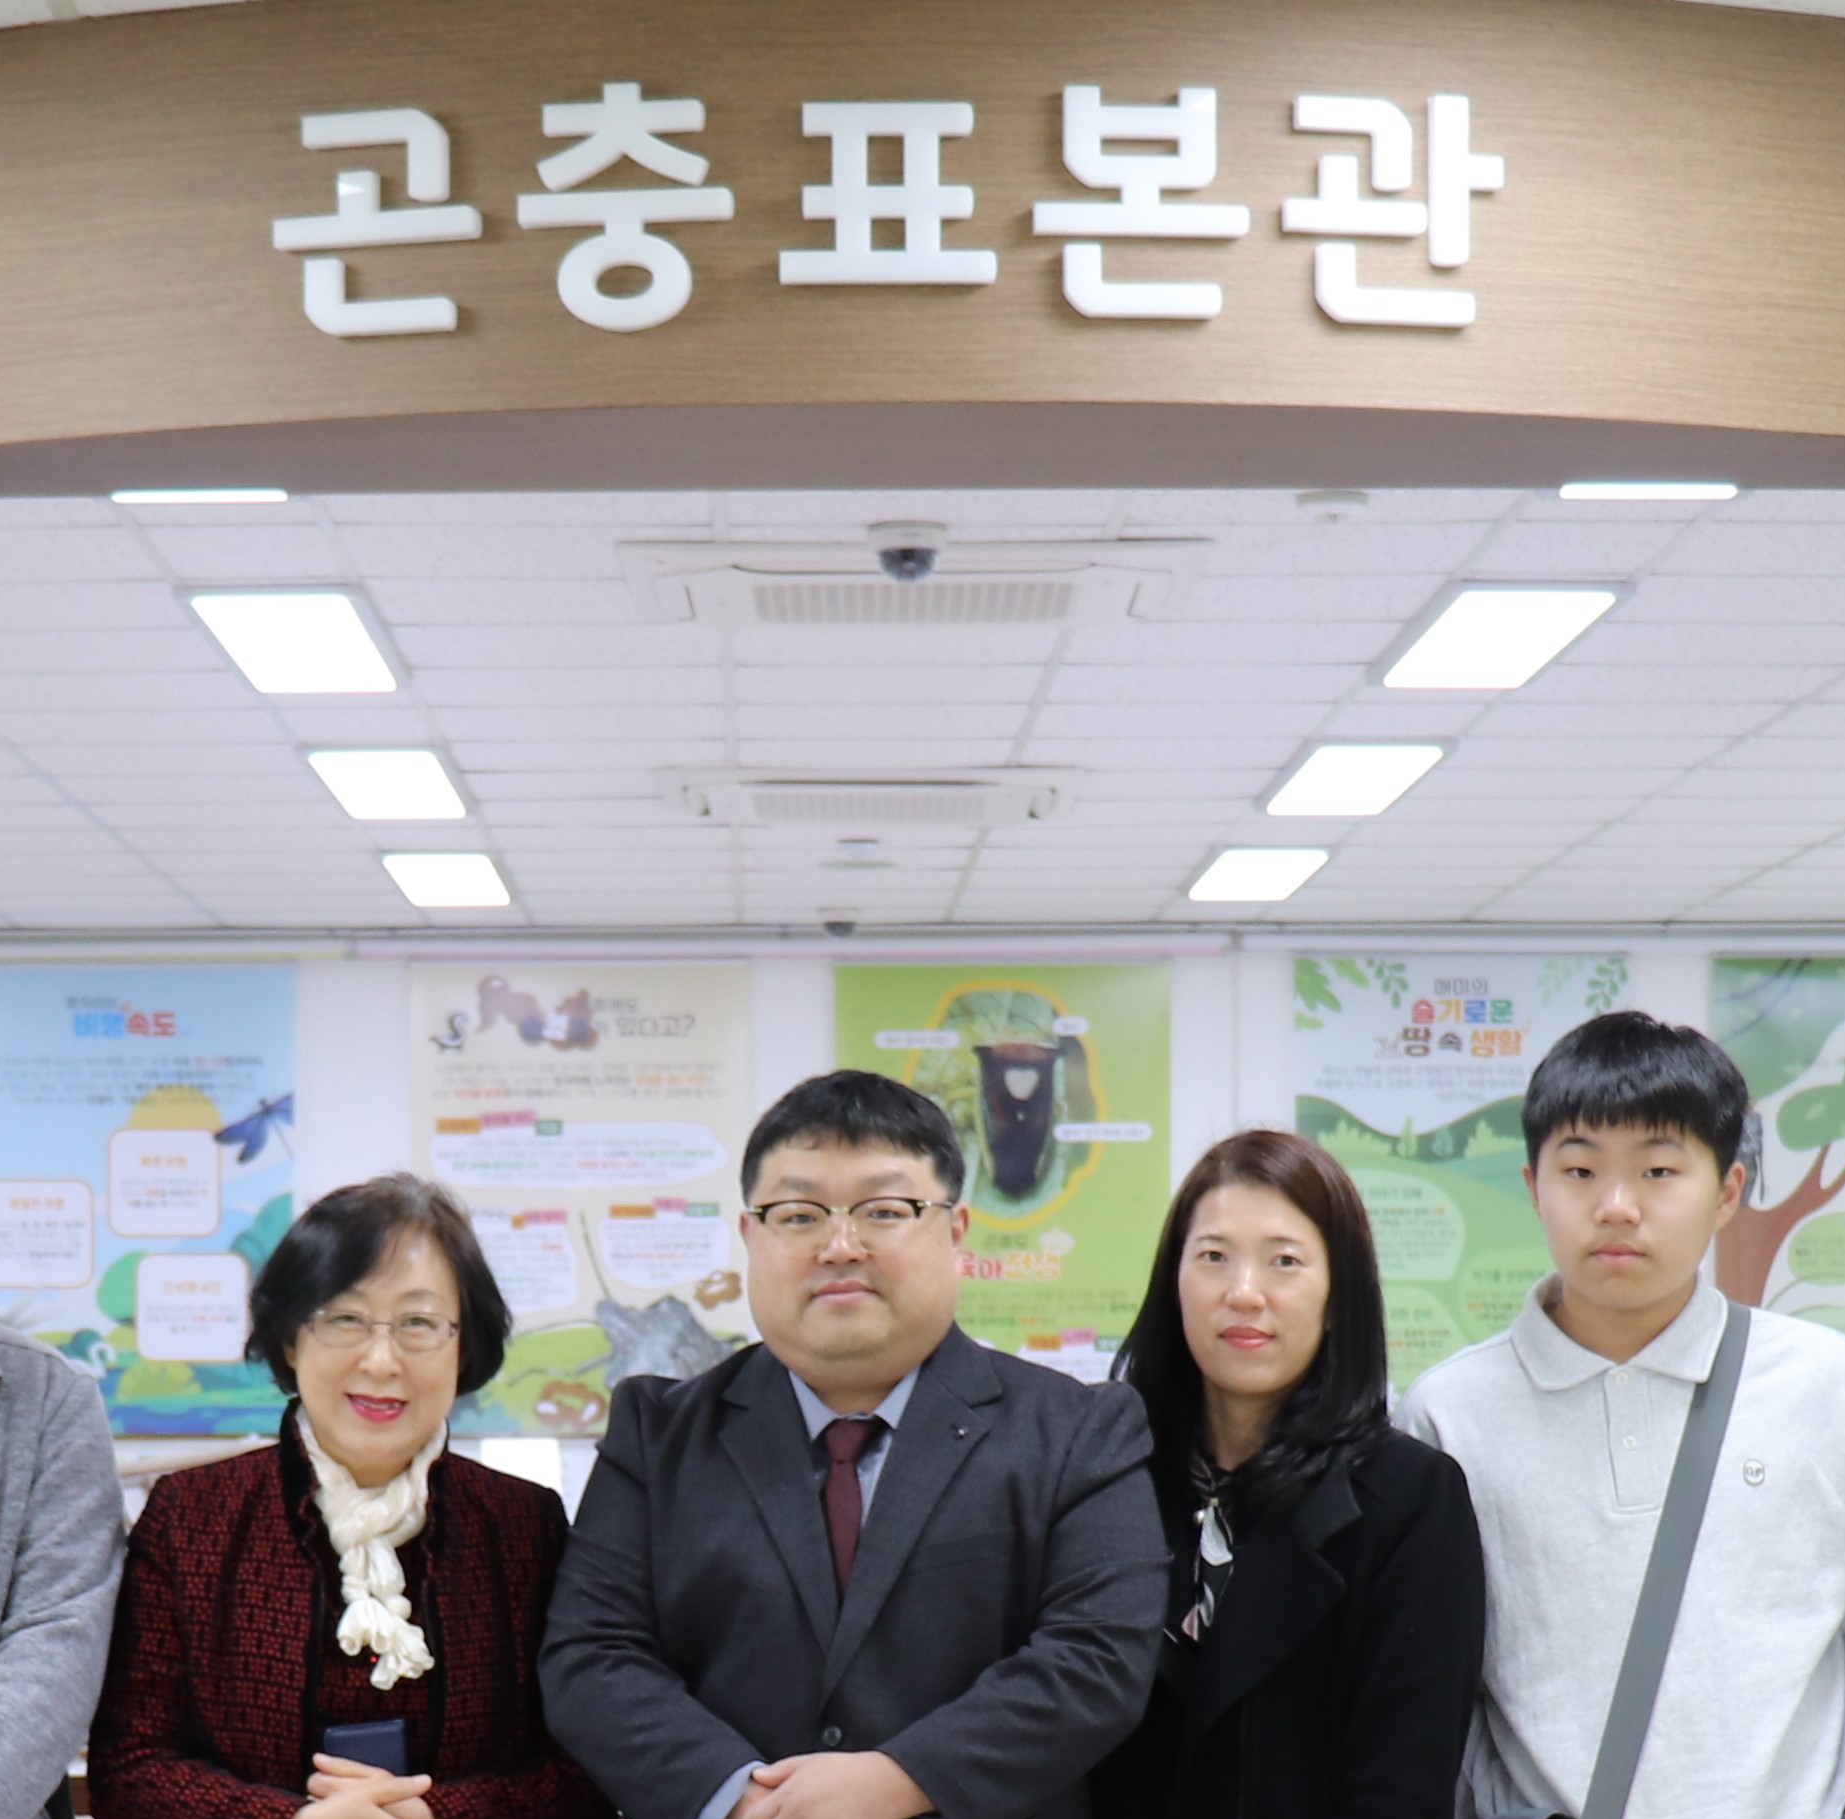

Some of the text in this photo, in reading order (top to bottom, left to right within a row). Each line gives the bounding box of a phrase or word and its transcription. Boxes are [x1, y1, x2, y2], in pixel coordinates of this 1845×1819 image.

[272, 81, 1505, 336] 곤충표본관
[1434, 978, 1488, 996] 매미의
[1412, 998, 1512, 1024] 슬기로운
[617, 1013, 696, 1037] 있다고?
[1402, 1027, 1522, 1058] 땅 속 생활
